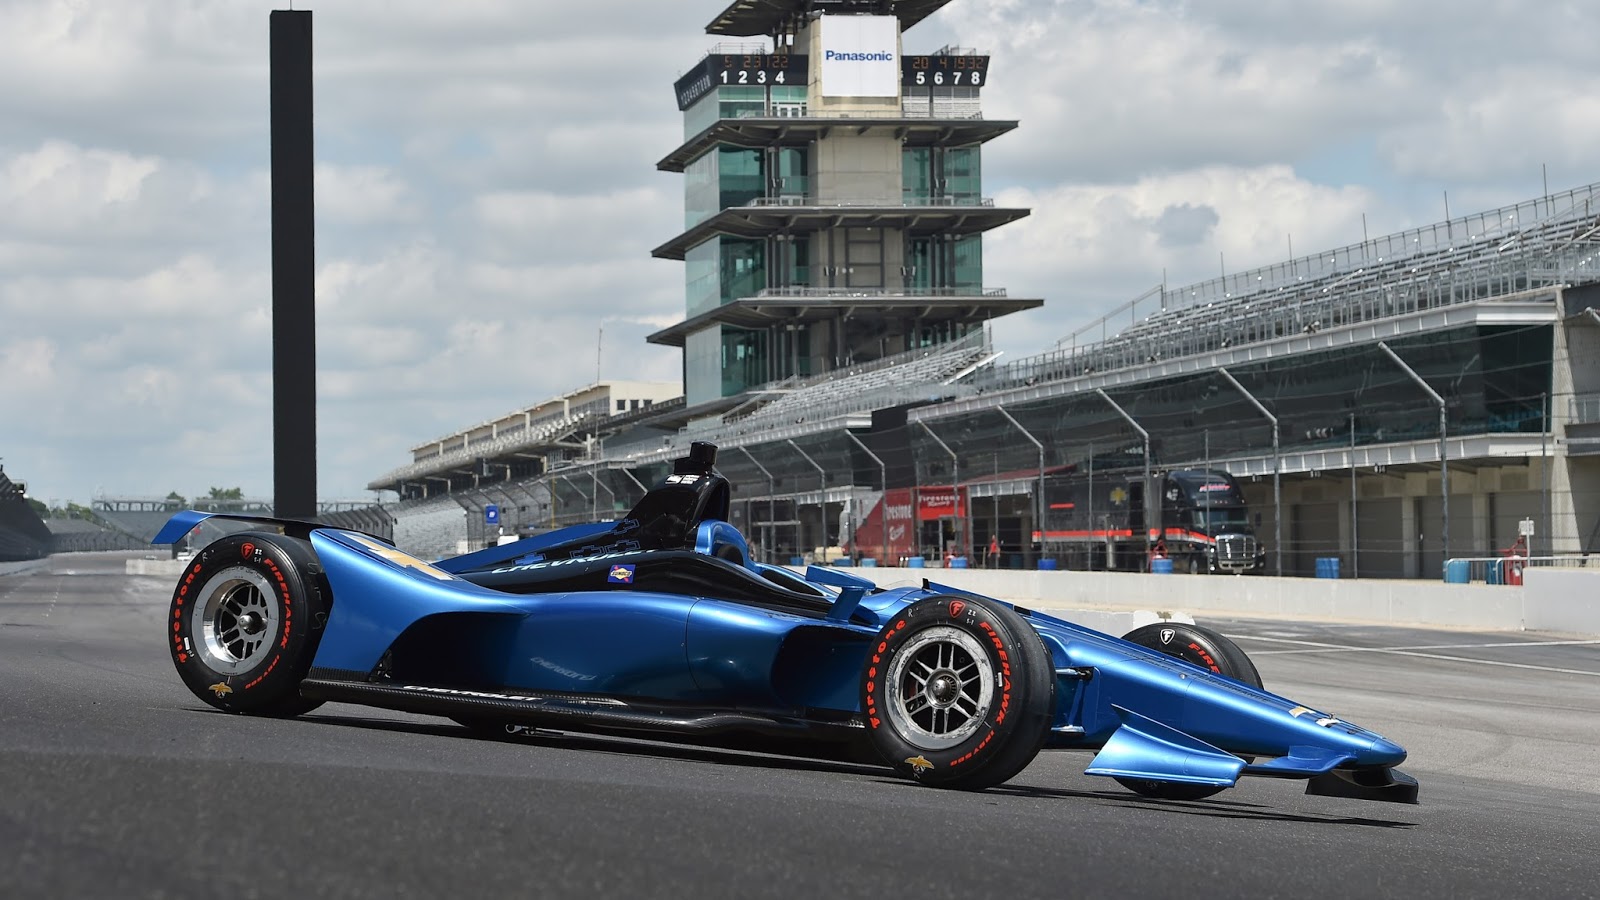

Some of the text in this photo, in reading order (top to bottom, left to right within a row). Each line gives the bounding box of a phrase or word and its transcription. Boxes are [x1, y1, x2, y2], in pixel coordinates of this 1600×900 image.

[720, 70, 785, 84] 1 2 3 4
[826, 50, 893, 61] Panasonic
[916, 72, 981, 85] 5 6 7 8
[174, 565, 201, 662] Firestone
[265, 559, 291, 647] FIREHAWK
[867, 621, 905, 728] Firestone
[980, 622, 1010, 723] FIREHAWK
